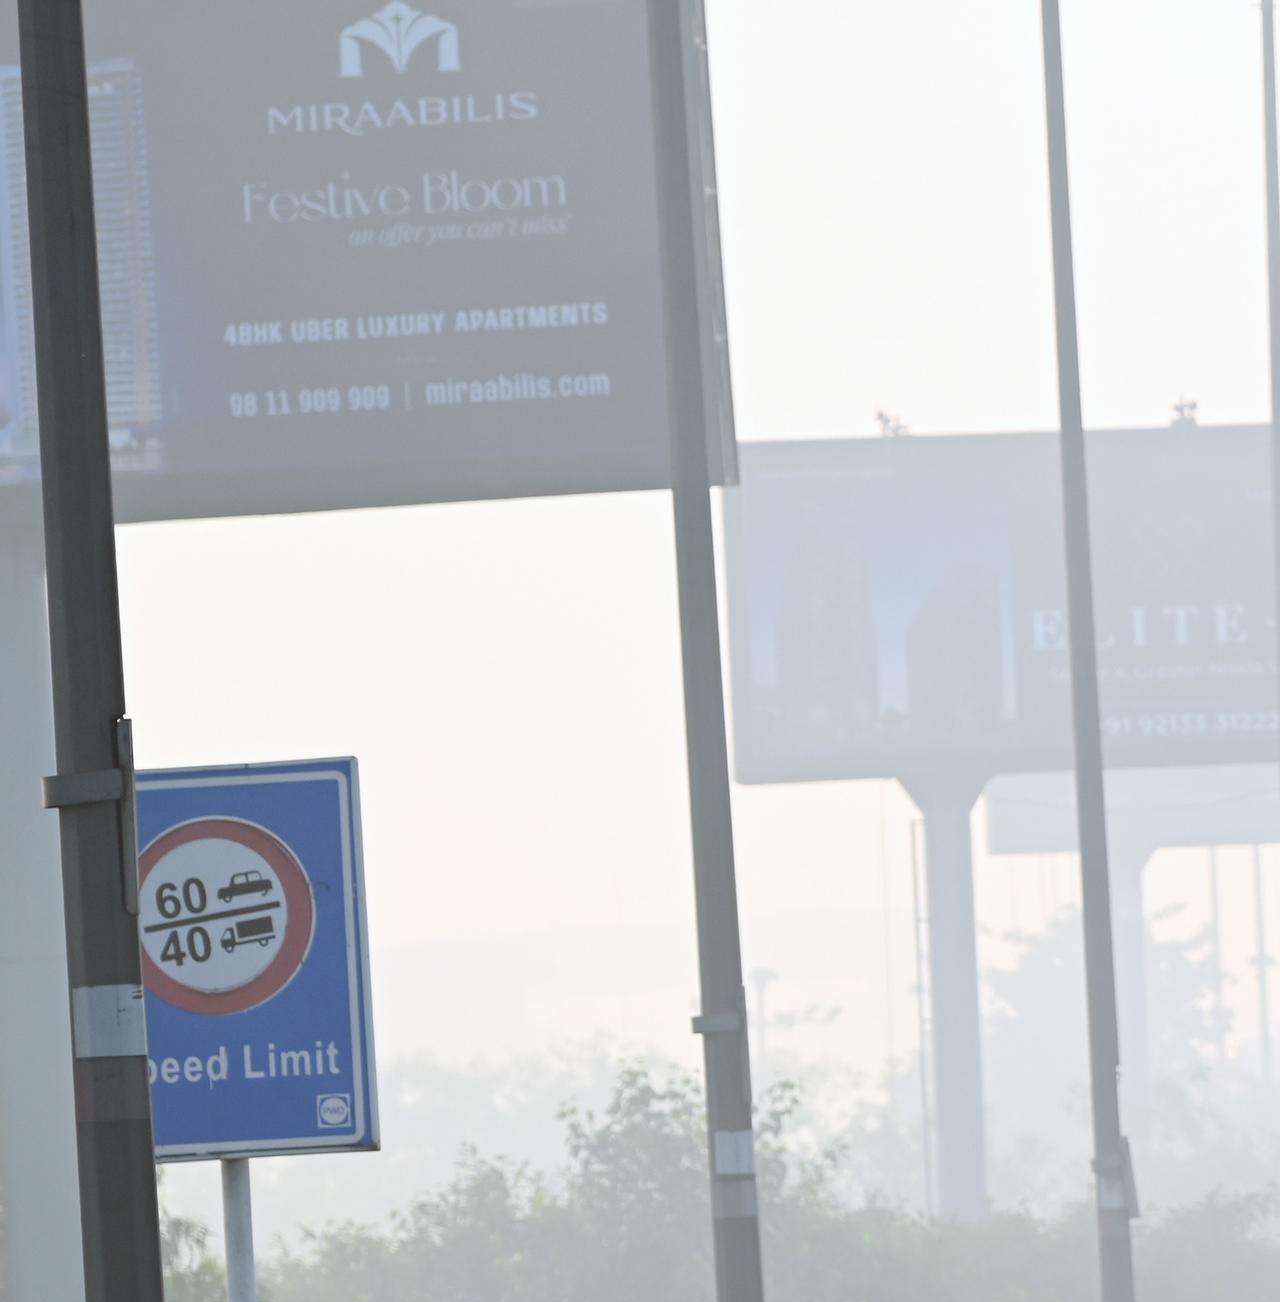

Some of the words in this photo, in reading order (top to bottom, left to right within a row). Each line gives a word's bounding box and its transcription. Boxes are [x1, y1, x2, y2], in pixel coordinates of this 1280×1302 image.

[267, 91, 539, 136] MIRAABILIS
[242, 169, 411, 224] Festive
[422, 169, 568, 214] Bloom
[425, 222, 464, 248] you
[224, 322, 283, 346] 4BHK
[291, 318, 349, 343] UBER
[356, 311, 445, 340] LUXURY
[454, 302, 608, 332] APARTMENTS
[265, 389, 291, 416] 11
[298, 387, 341, 413] 909
[347, 384, 391, 411] 909
[425, 373, 611, 406] miraabilis.com
[155, 877, 208, 919] 60
[160, 926, 212, 967] 40
[147, 1046, 228, 1085] peed
[243, 1040, 340, 1080] Limit
